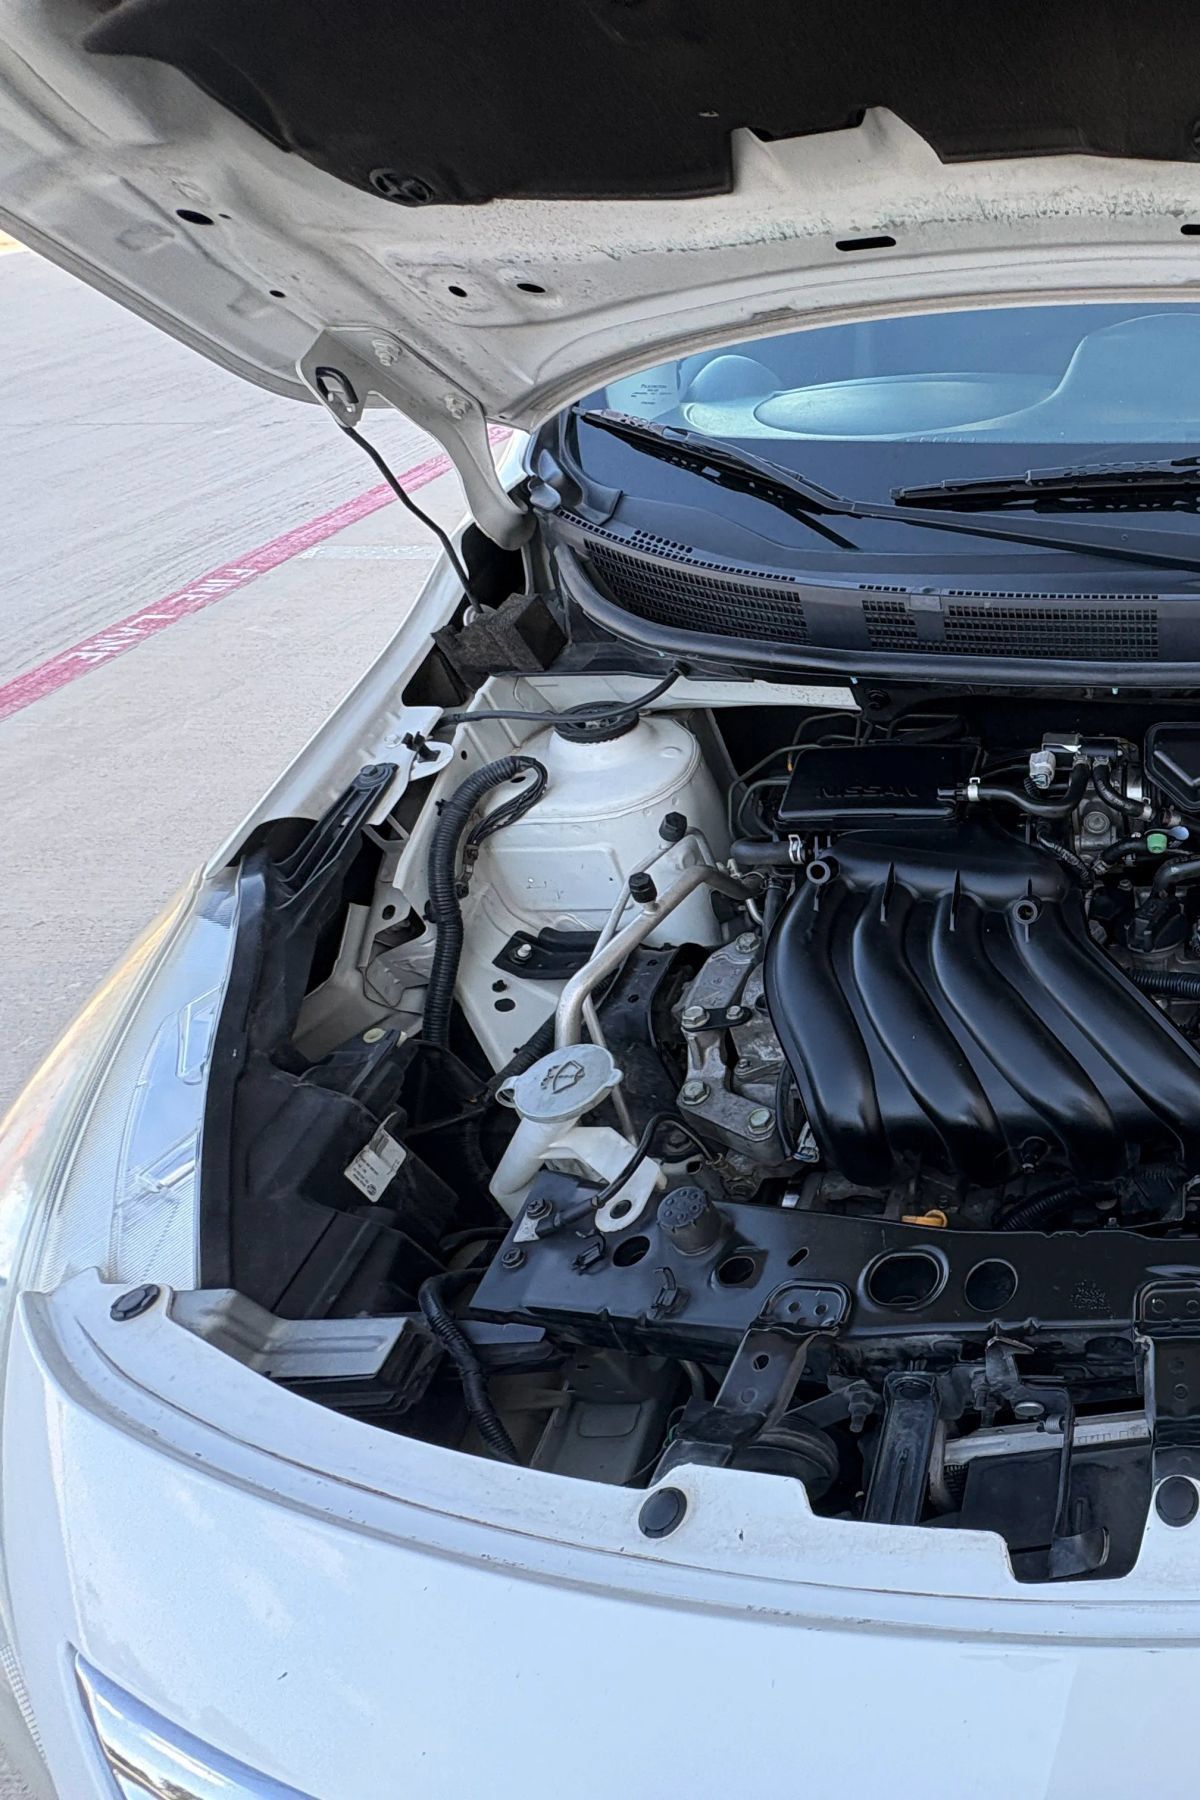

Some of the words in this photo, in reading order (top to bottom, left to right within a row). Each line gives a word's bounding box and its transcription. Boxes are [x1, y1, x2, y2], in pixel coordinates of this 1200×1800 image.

[173, 568, 258, 601] FIRE
[58, 614, 177, 665] LANE
[815, 783, 919, 799] NISSAN
